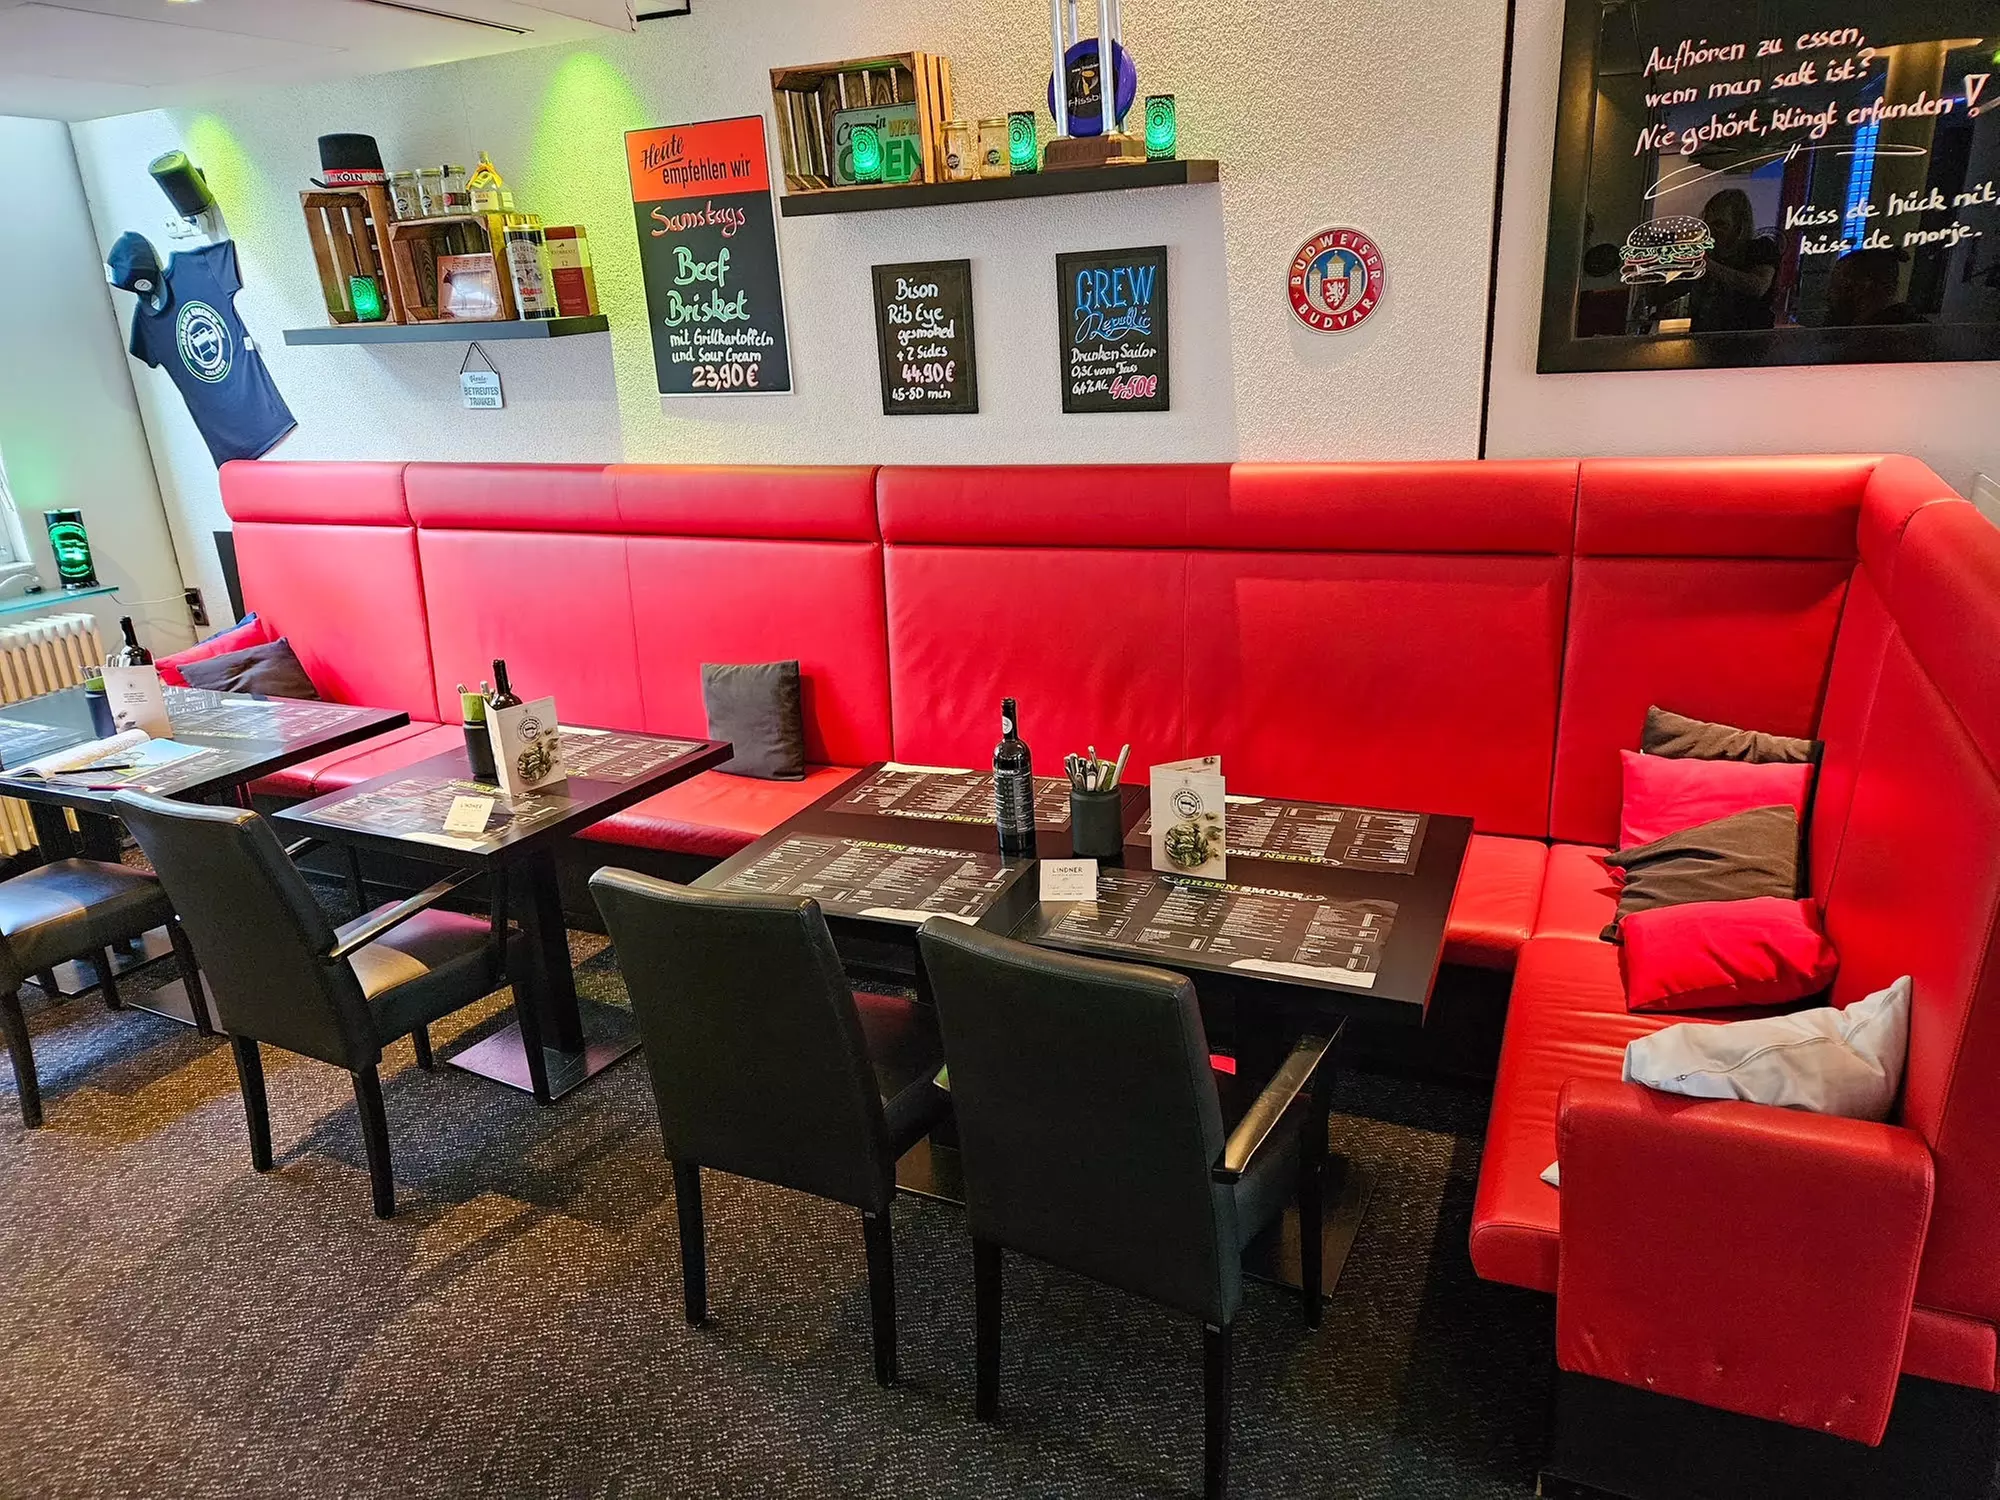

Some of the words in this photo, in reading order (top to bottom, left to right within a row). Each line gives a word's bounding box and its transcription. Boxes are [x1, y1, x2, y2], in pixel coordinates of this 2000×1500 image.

[1643, 39, 1746, 78] Aufhören
[1756, 38, 1783, 58] zu
[1797, 26, 1866, 50] essen,
[1645, 87, 1698, 108] wenn
[1708, 77, 1762, 99] man
[1825, 47, 1876, 82] ist?
[1633, 124, 1676, 157] Nie
[1680, 111, 1770, 156] gehört,
[1771, 101, 1838, 140] klingt
[641, 133, 685, 171] Heute
[838, 139, 922, 182] OEN
[336, 171, 363, 182] KÖLN
[662, 158, 728, 188] empfehlen
[731, 154, 751, 178] wir
[650, 200, 746, 239] Samstags
[1784, 204, 1839, 231] Küss
[1846, 197, 1881, 219] de
[1887, 186, 1948, 217] hück
[1799, 235, 1852, 256] küss
[1861, 229, 1894, 251] de
[672, 246, 731, 288] Beef
[1291, 234, 1380, 285] BUDWEISER
[895, 277, 939, 301] Bison
[1075, 264, 1156, 309] CREW
[664, 288, 750, 328] Brisket
[887, 303, 913, 325] Rib
[914, 302, 945, 328] Eye
[1298, 298, 1374, 329] BUDVAR
[670, 328, 692, 348] mit
[693, 327, 774, 347] Grillkartoffeln
[897, 318, 956, 346] gesmoked
[671, 346, 696, 364] und
[698, 347, 724, 362] Sour
[725, 347, 762, 363] Cream
[906, 346, 916, 361] 2
[917, 343, 949, 359] Sides
[1071, 343, 1120, 365] Drunken
[1120, 341, 1157, 359] Sailor
[1094, 366, 1116, 376] vom
[927, 383, 952, 400] min
[1225, 848, 1261, 858] SMO
[1052, 866, 1083, 874] LINDNER
[1179, 877, 1239, 892] GREEN
[1240, 885, 1304, 900] SMOKE
